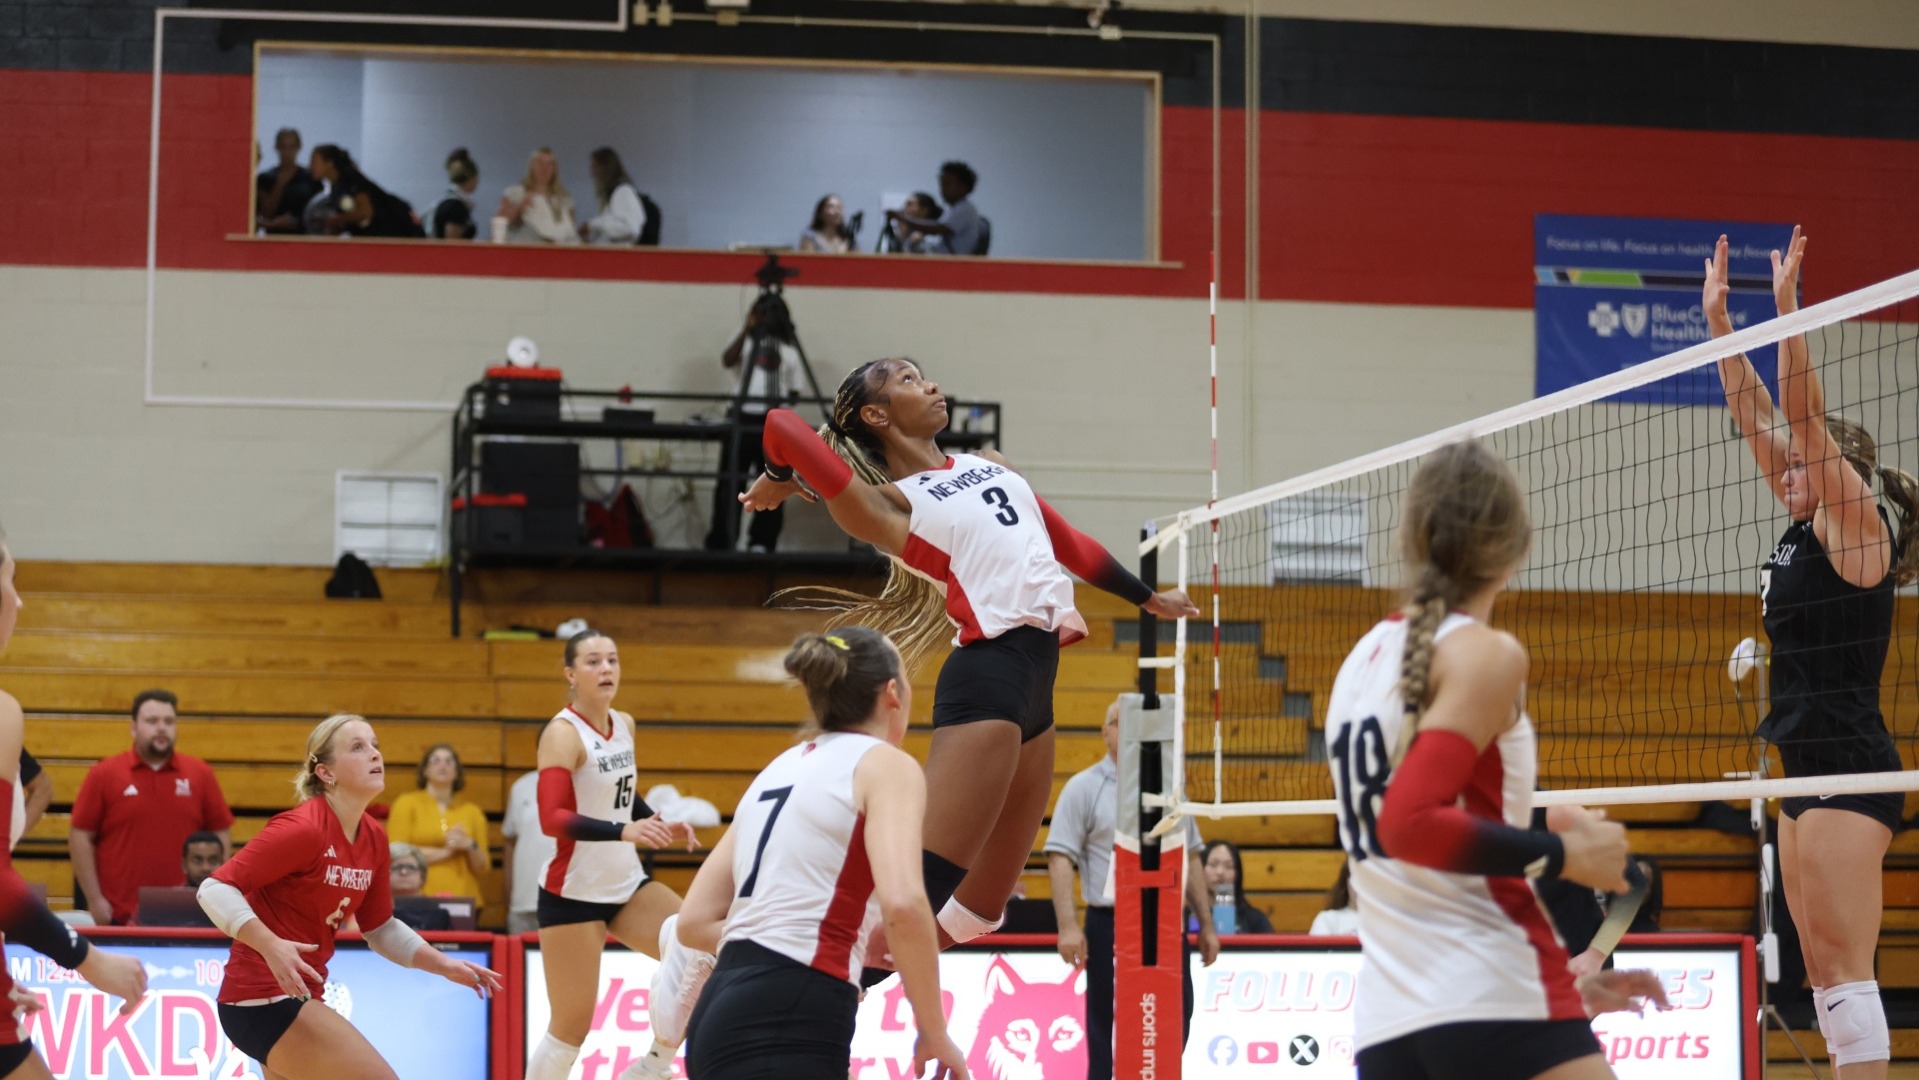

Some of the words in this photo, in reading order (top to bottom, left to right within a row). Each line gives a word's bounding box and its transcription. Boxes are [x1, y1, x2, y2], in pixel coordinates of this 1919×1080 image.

[1651, 303, 1745, 326] BlueCe
[1651, 322, 1711, 341] Health
[981, 487, 1019, 526] 3
[614, 774, 633, 810] 15
[1331, 715, 1390, 862] 18
[738, 784, 795, 898] 7
[323, 864, 372, 891] NEWBERRY
[195, 960, 225, 986] 10
[1203, 971, 1357, 1012] FOLLO
[1139, 992, 1157, 1047] sports
